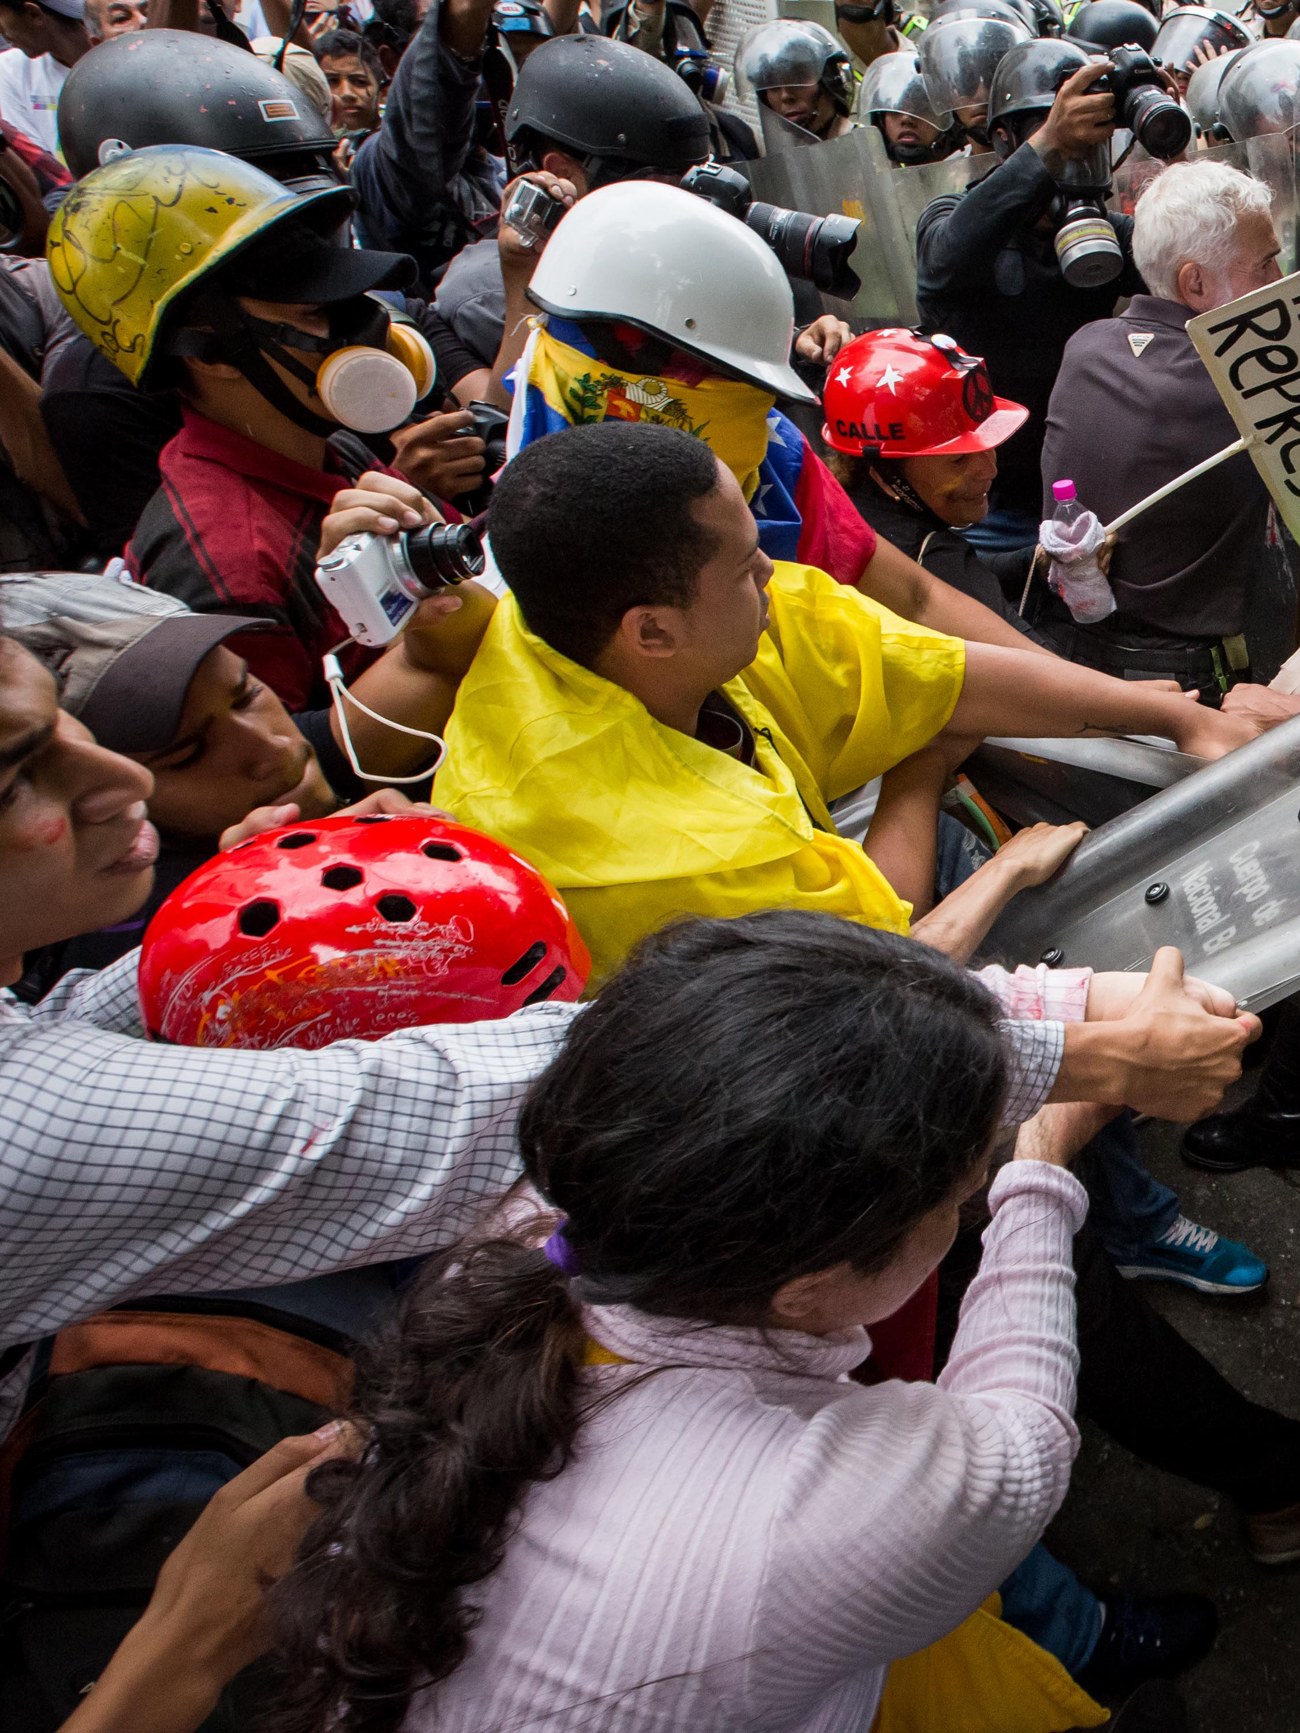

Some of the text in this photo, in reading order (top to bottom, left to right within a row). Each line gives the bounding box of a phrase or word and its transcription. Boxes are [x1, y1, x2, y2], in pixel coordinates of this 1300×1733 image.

[836, 419, 906, 440] CALLE
[1180, 860, 1231, 936] Nacional
[1229, 841, 1287, 927] Cuerpo de
